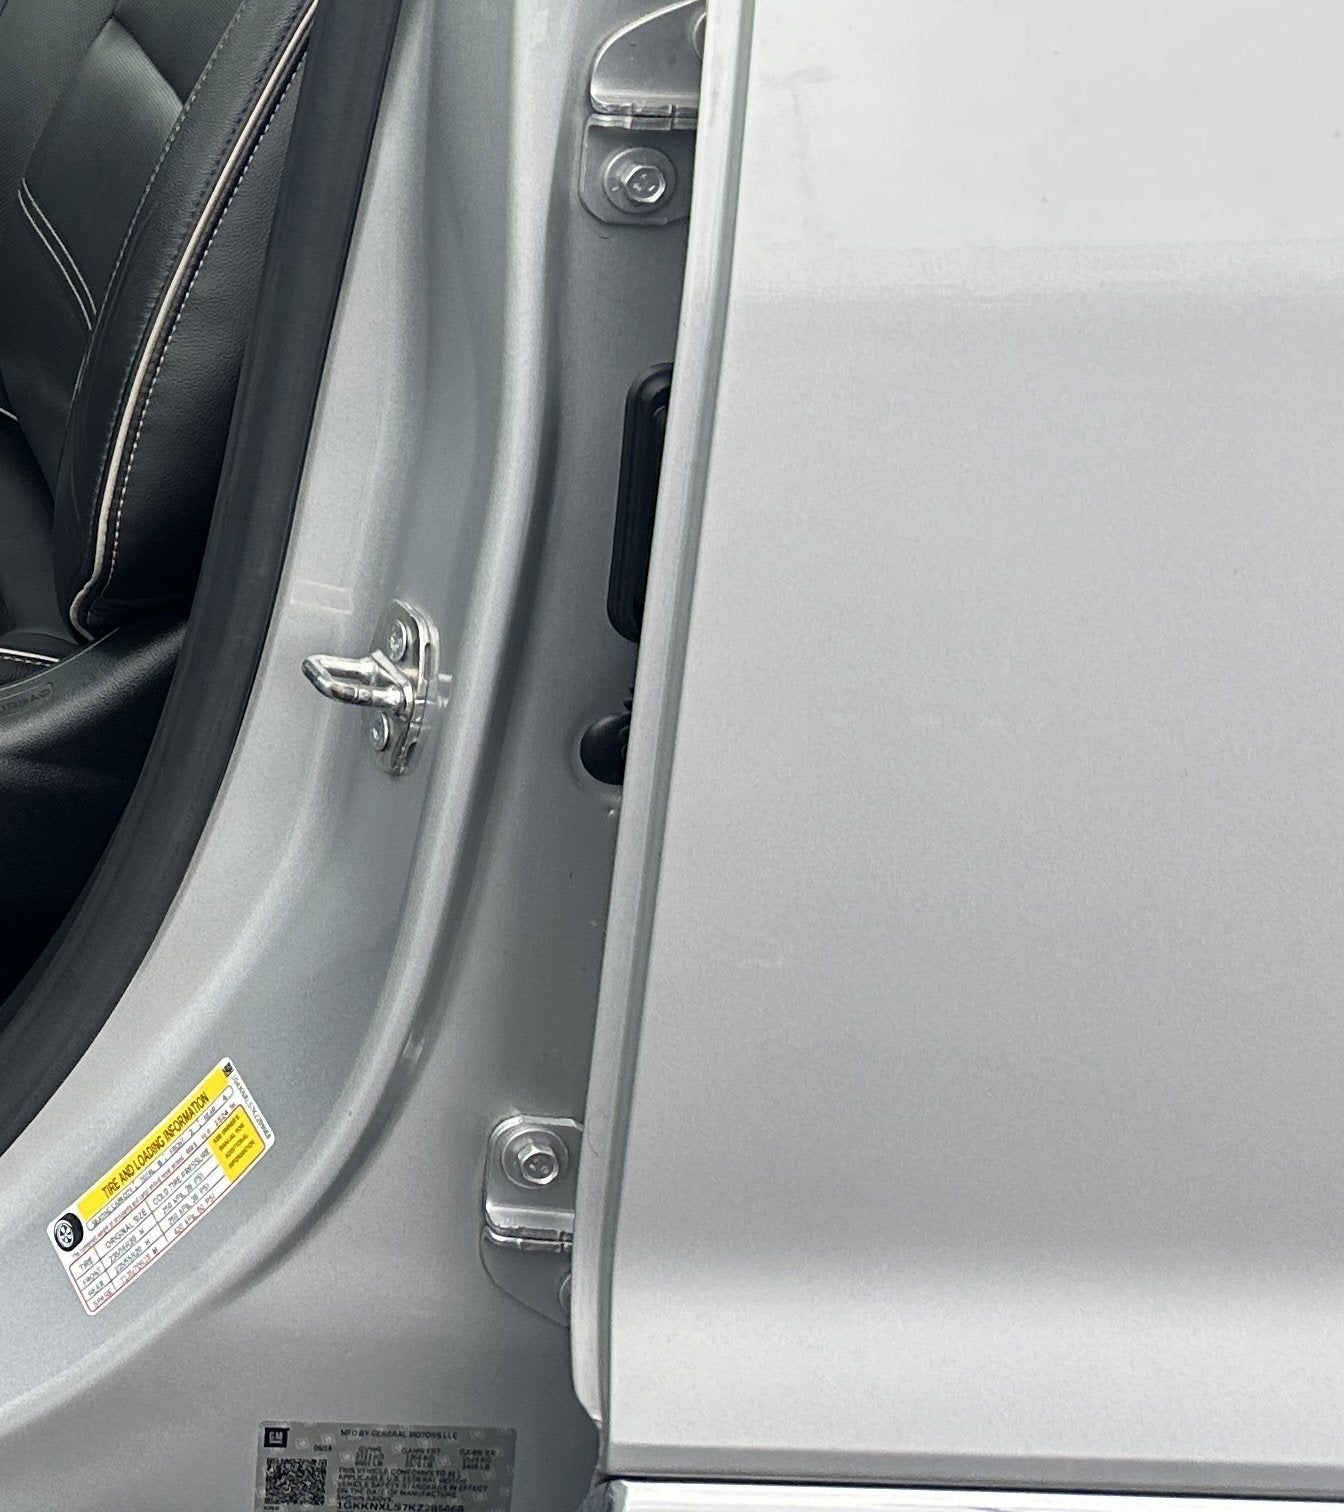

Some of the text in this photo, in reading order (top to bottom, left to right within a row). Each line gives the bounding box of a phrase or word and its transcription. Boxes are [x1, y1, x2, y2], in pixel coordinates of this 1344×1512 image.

[101, 1089, 210, 1199] TIRE AND LOADING INFORMATION
